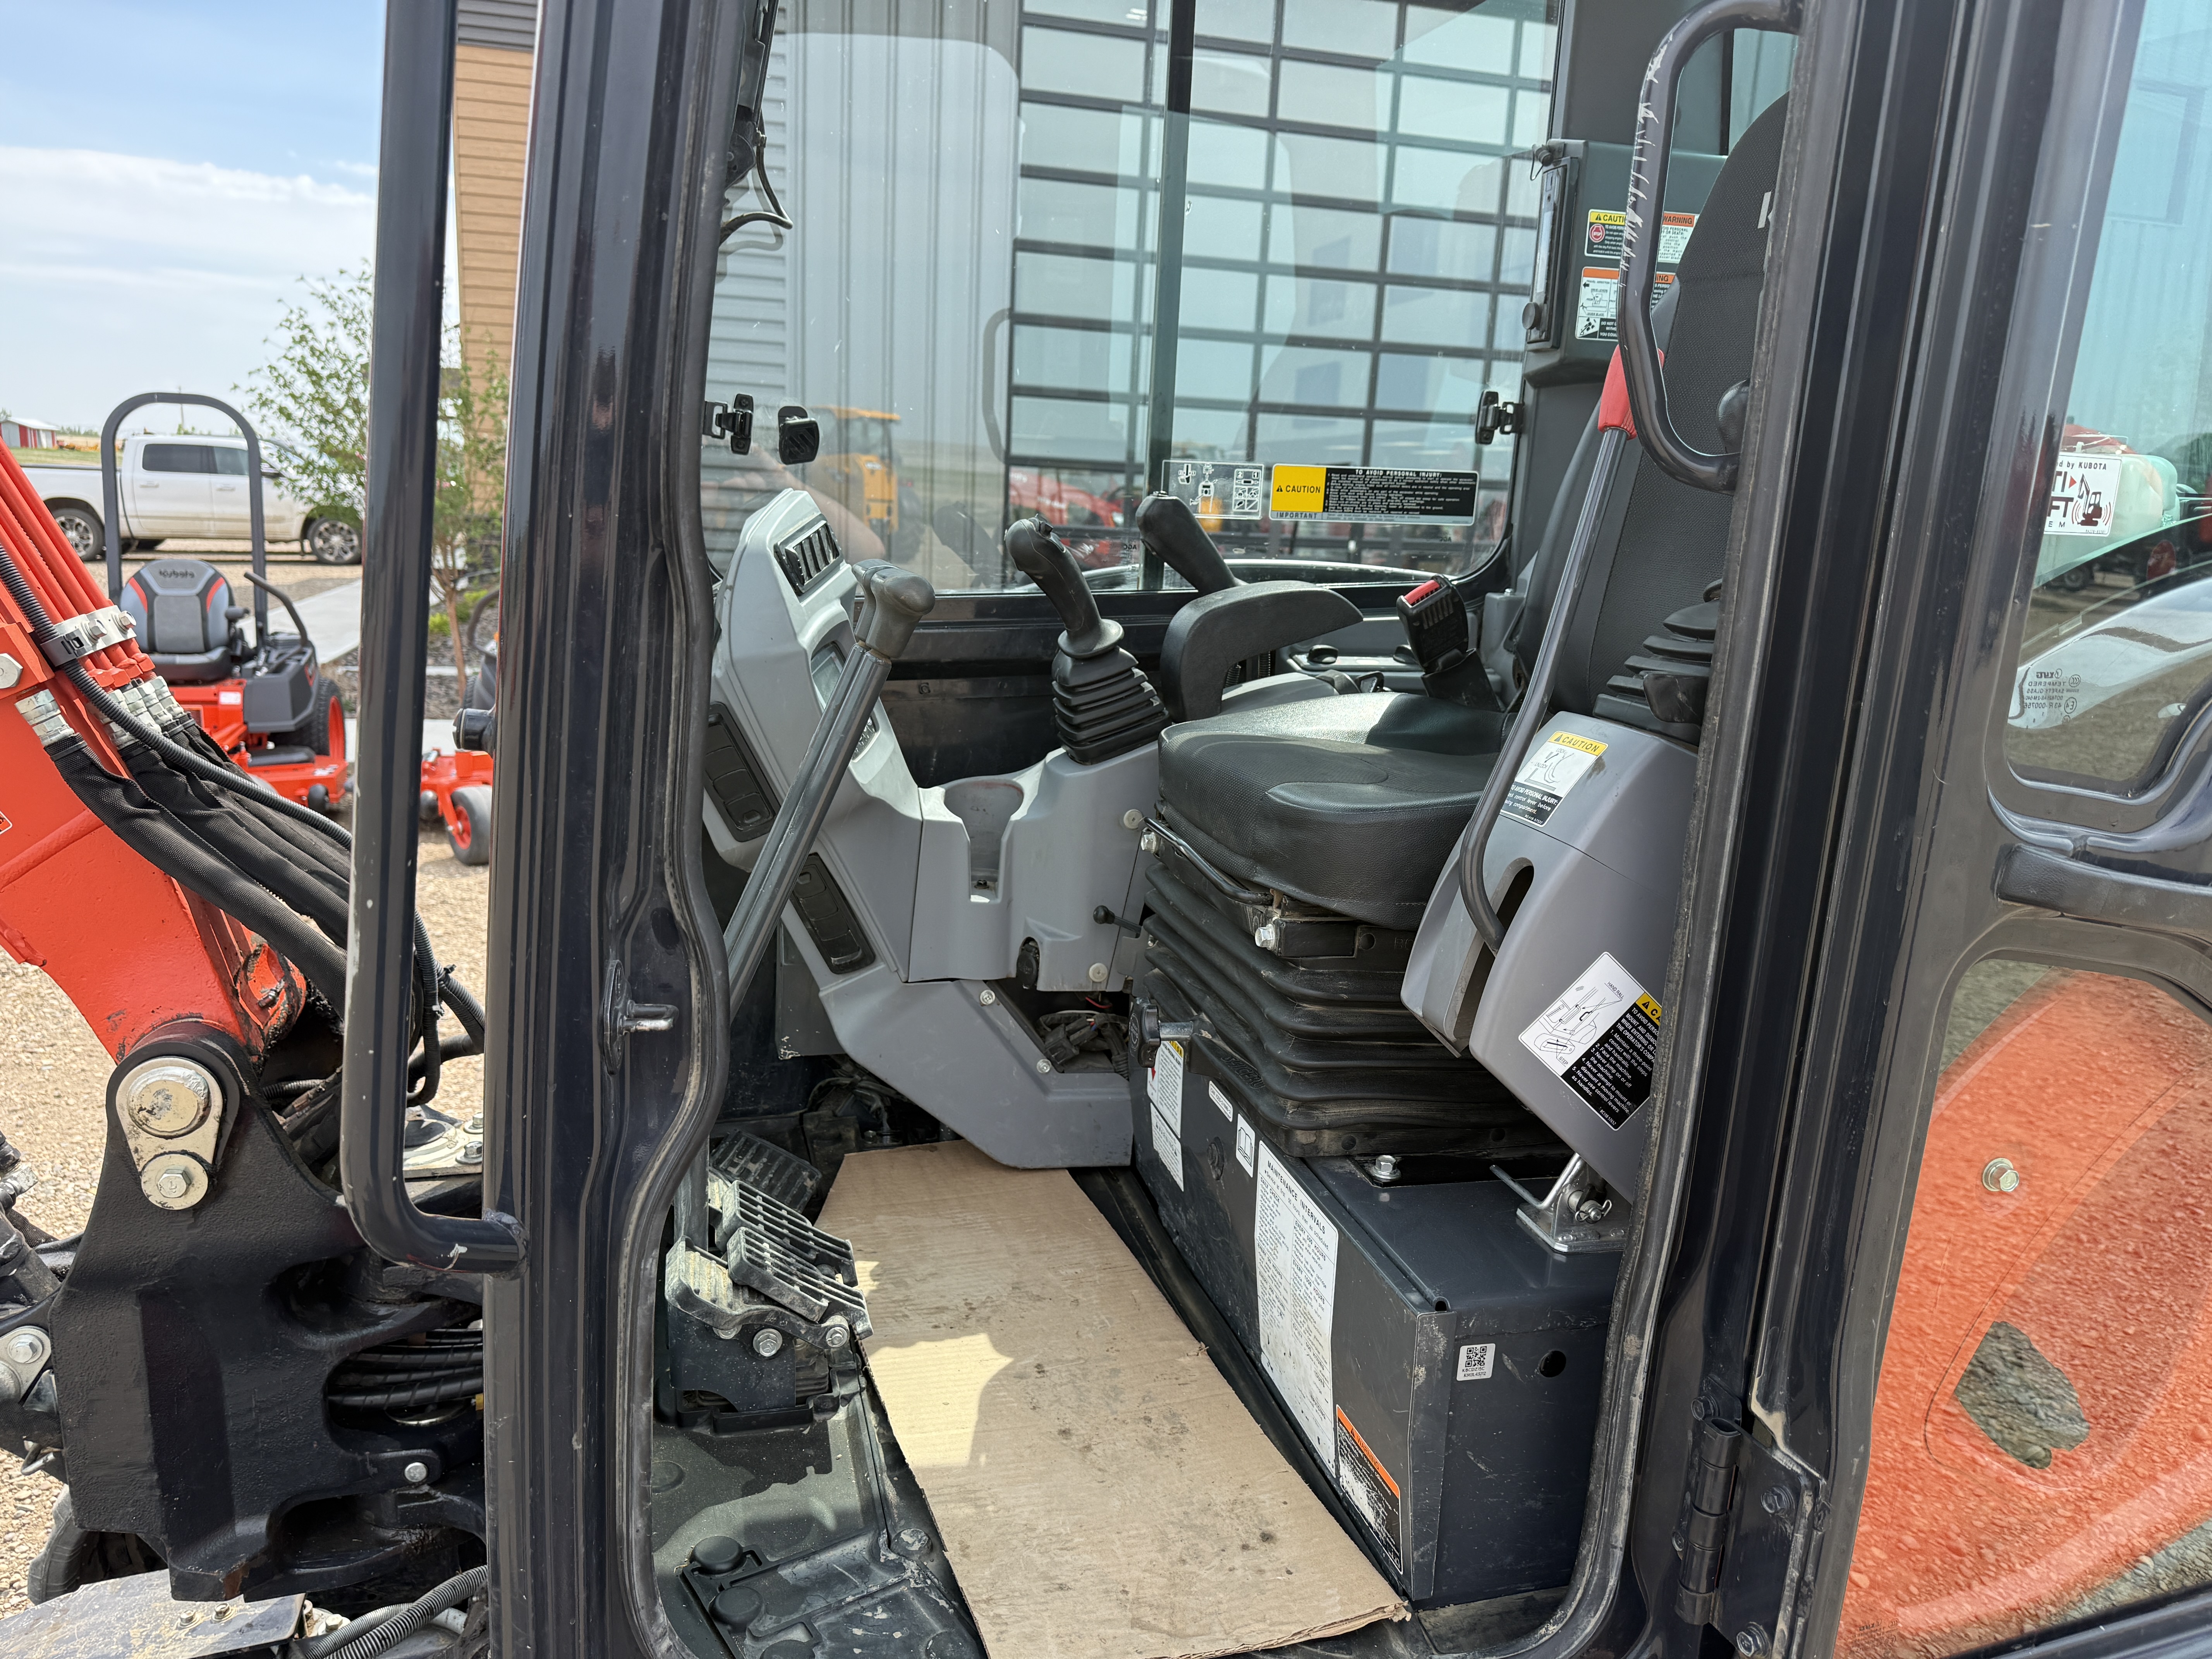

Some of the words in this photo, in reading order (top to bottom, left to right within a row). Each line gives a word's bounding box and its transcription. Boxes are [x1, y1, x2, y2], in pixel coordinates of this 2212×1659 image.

[2067, 461, 2075, 469] by
[2078, 462, 2107, 470] KUBOTA
[1285, 484, 1321, 493] CAUTION
[1562, 737, 1600, 752] CAUTION
[1523, 788, 1543, 800] PERSONAL
[1537, 802, 1551, 811] before
[1607, 981, 1617, 992] HAND
[1621, 1018, 1632, 1030] WHEN
[1631, 1028, 1649, 1046] ENTERING
[1626, 1013, 1639, 1027] MOUNT
[1637, 1026, 1646, 1034] AND
[1636, 1013, 1648, 1025] AVOID
[1616, 1023, 1625, 1032] THE
[1623, 1030, 1645, 1051] OPERATOR'S
[1595, 1051, 1607, 1064] Never
[1605, 1062, 1616, 1073] jump
[1600, 1047, 1610, 1058] Face
[1616, 1063, 1632, 1080] machine.
[1604, 1043, 1613, 1051] and
[1612, 1049, 1629, 1068] handrails.
[1609, 1039, 1623, 1053] contact
[1623, 1052, 1631, 1060] with
[1637, 1066, 1648, 1077] steps
[1614, 1033, 1630, 1050] Maintain
[1632, 1051, 1652, 1072] three-point
[1585, 1061, 1598, 1073] Never
[1597, 1073, 1612, 1087] attempt
[1615, 1089, 1628, 1103] mount
[1597, 1063, 1613, 1080] machine.
[1576, 1070, 1589, 1083] Never
[1595, 1089, 1608, 1102] control
[1607, 1100, 1620, 1113] levers
[1577, 1080, 1592, 1097] handles.
[1581, 1066, 1599, 1083] dismount
[1601, 1085, 1614, 1099] moving
[1614, 1097, 1630, 1115] machine.
[1267, 1160, 1298, 1201] MAINTENANCE
[1300, 1199, 1326, 1234] INTERVALS
[1295, 1220, 1305, 1235] EVERY
[1314, 1244, 1326, 1261] HOURS
[1293, 1259, 1303, 1275] EVERY
[1313, 1286, 1325, 1305] HOURS
[1357, 1436, 1379, 1470] WARNING
